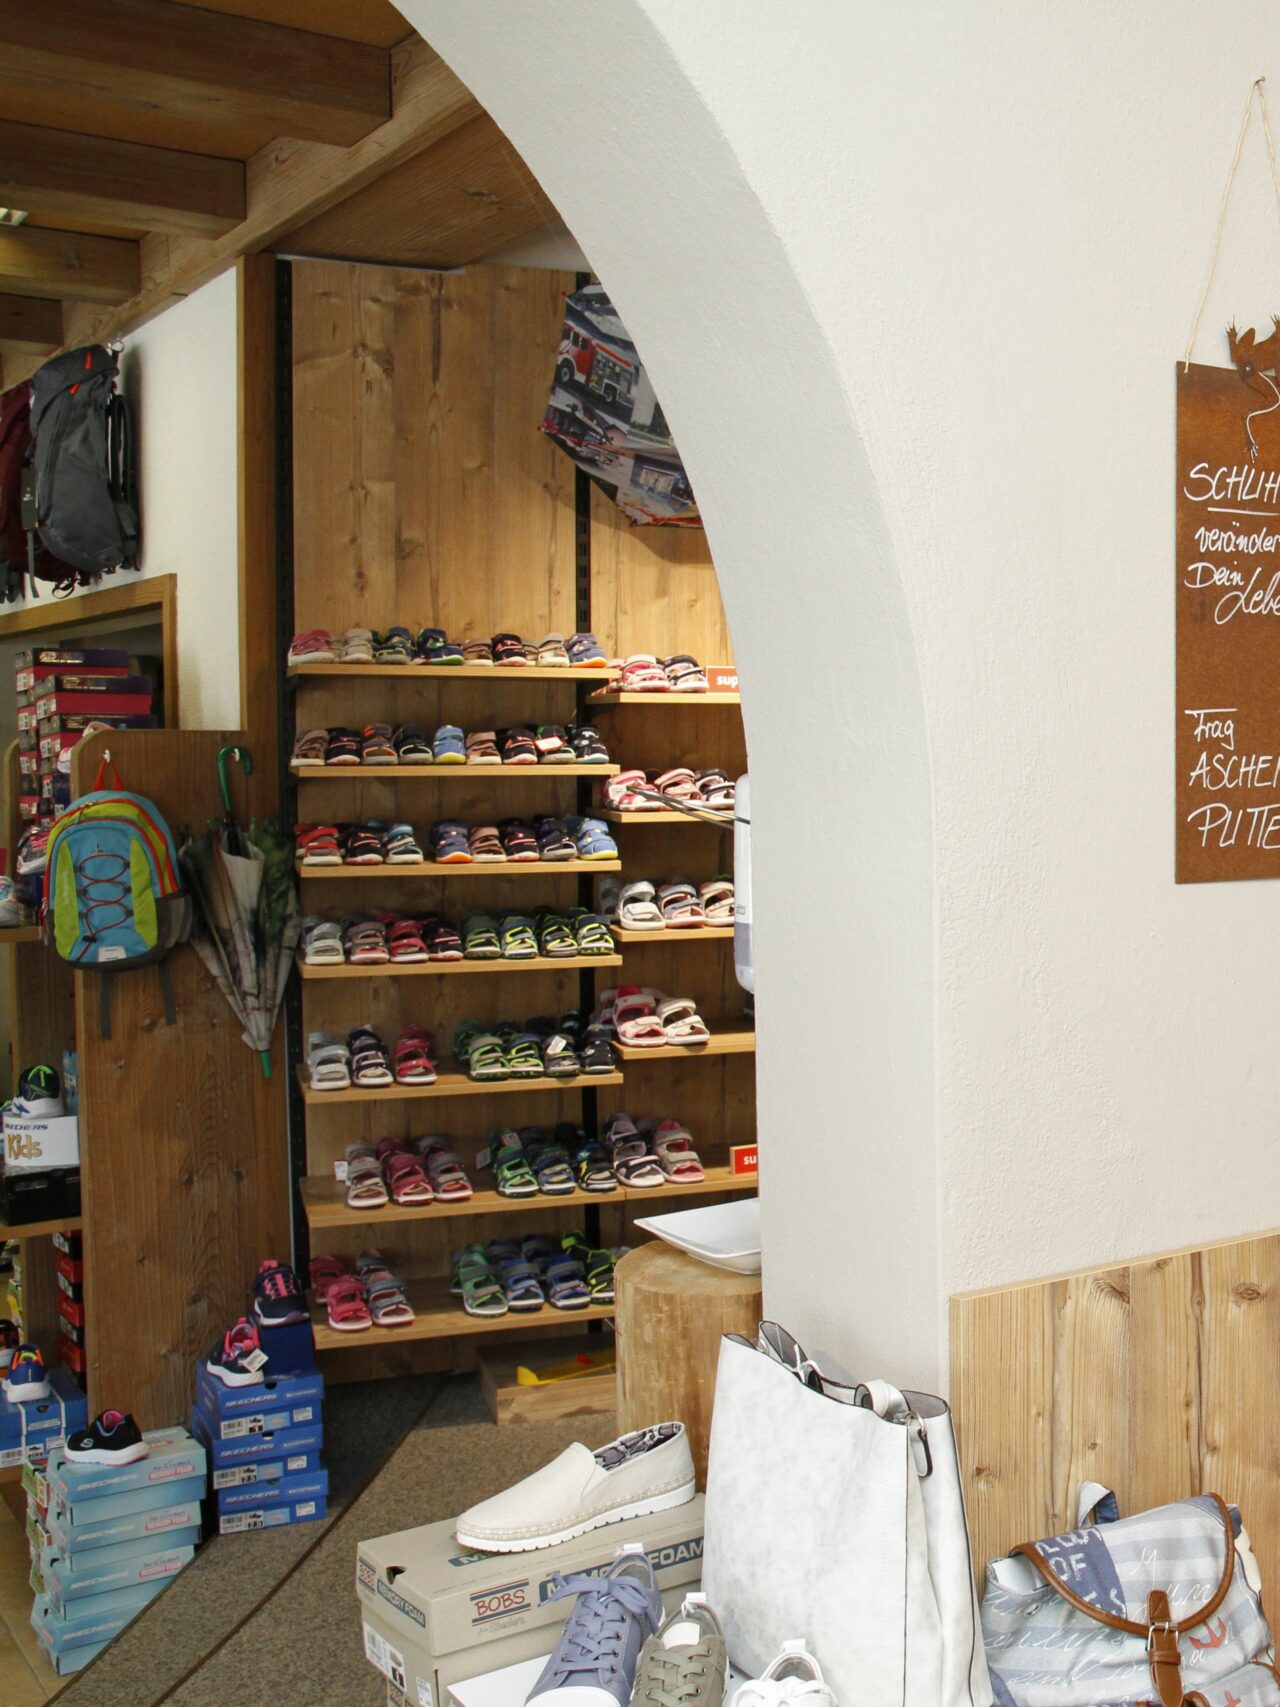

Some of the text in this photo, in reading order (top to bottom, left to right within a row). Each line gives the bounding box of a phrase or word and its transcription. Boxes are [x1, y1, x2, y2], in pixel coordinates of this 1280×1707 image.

[1184, 561, 1245, 588] Dein
[1184, 708, 1238, 750] Trag
[8, 1133, 43, 1160] Kids
[1049, 1552, 1087, 1582] OF
[378, 1580, 405, 1610] MEMORY
[404, 1602, 425, 1626] FOAM
[473, 1588, 526, 1617] BOBS
